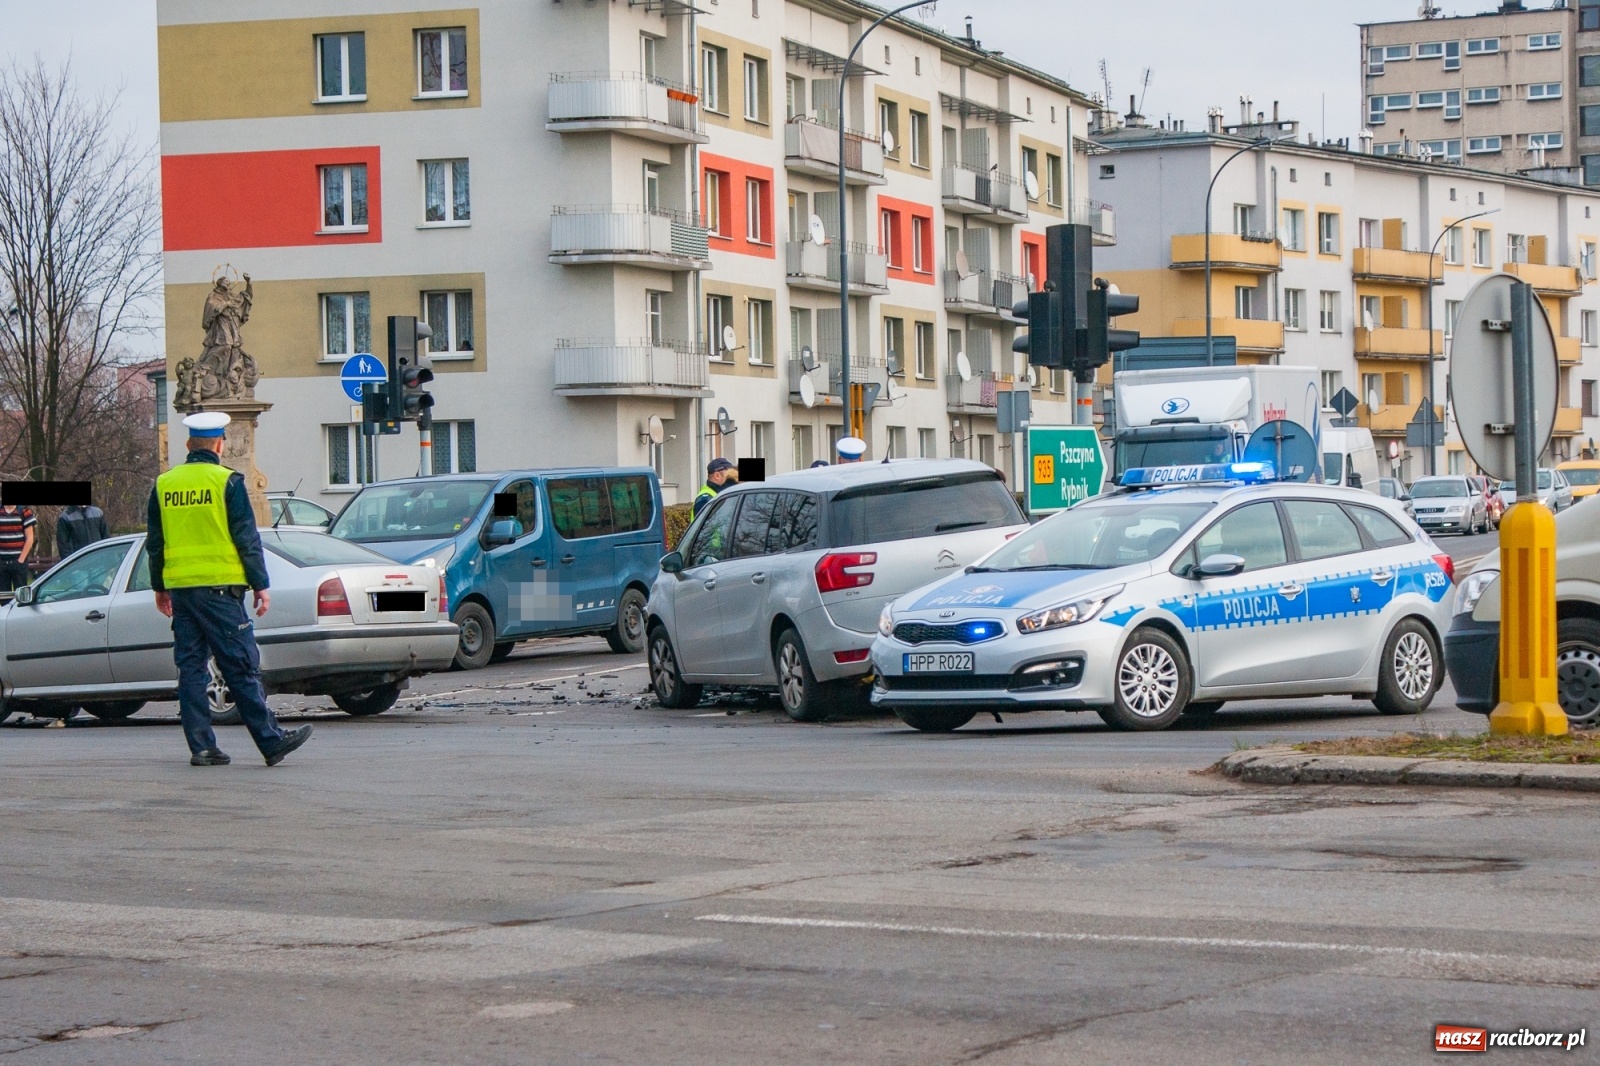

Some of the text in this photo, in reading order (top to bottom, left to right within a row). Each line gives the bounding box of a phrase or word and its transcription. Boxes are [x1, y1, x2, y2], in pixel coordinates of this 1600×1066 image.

[1060, 440, 1095, 470] Pszczyna
[1038, 459, 1051, 478] 935
[1153, 466, 1199, 483] POLICJA
[164, 489, 213, 507] POLICJA
[1061, 477, 1089, 507] Rybnik
[926, 594, 1005, 606] POLICJA
[1223, 595, 1281, 620] POLICJA
[910, 654, 971, 671] HPP R022
